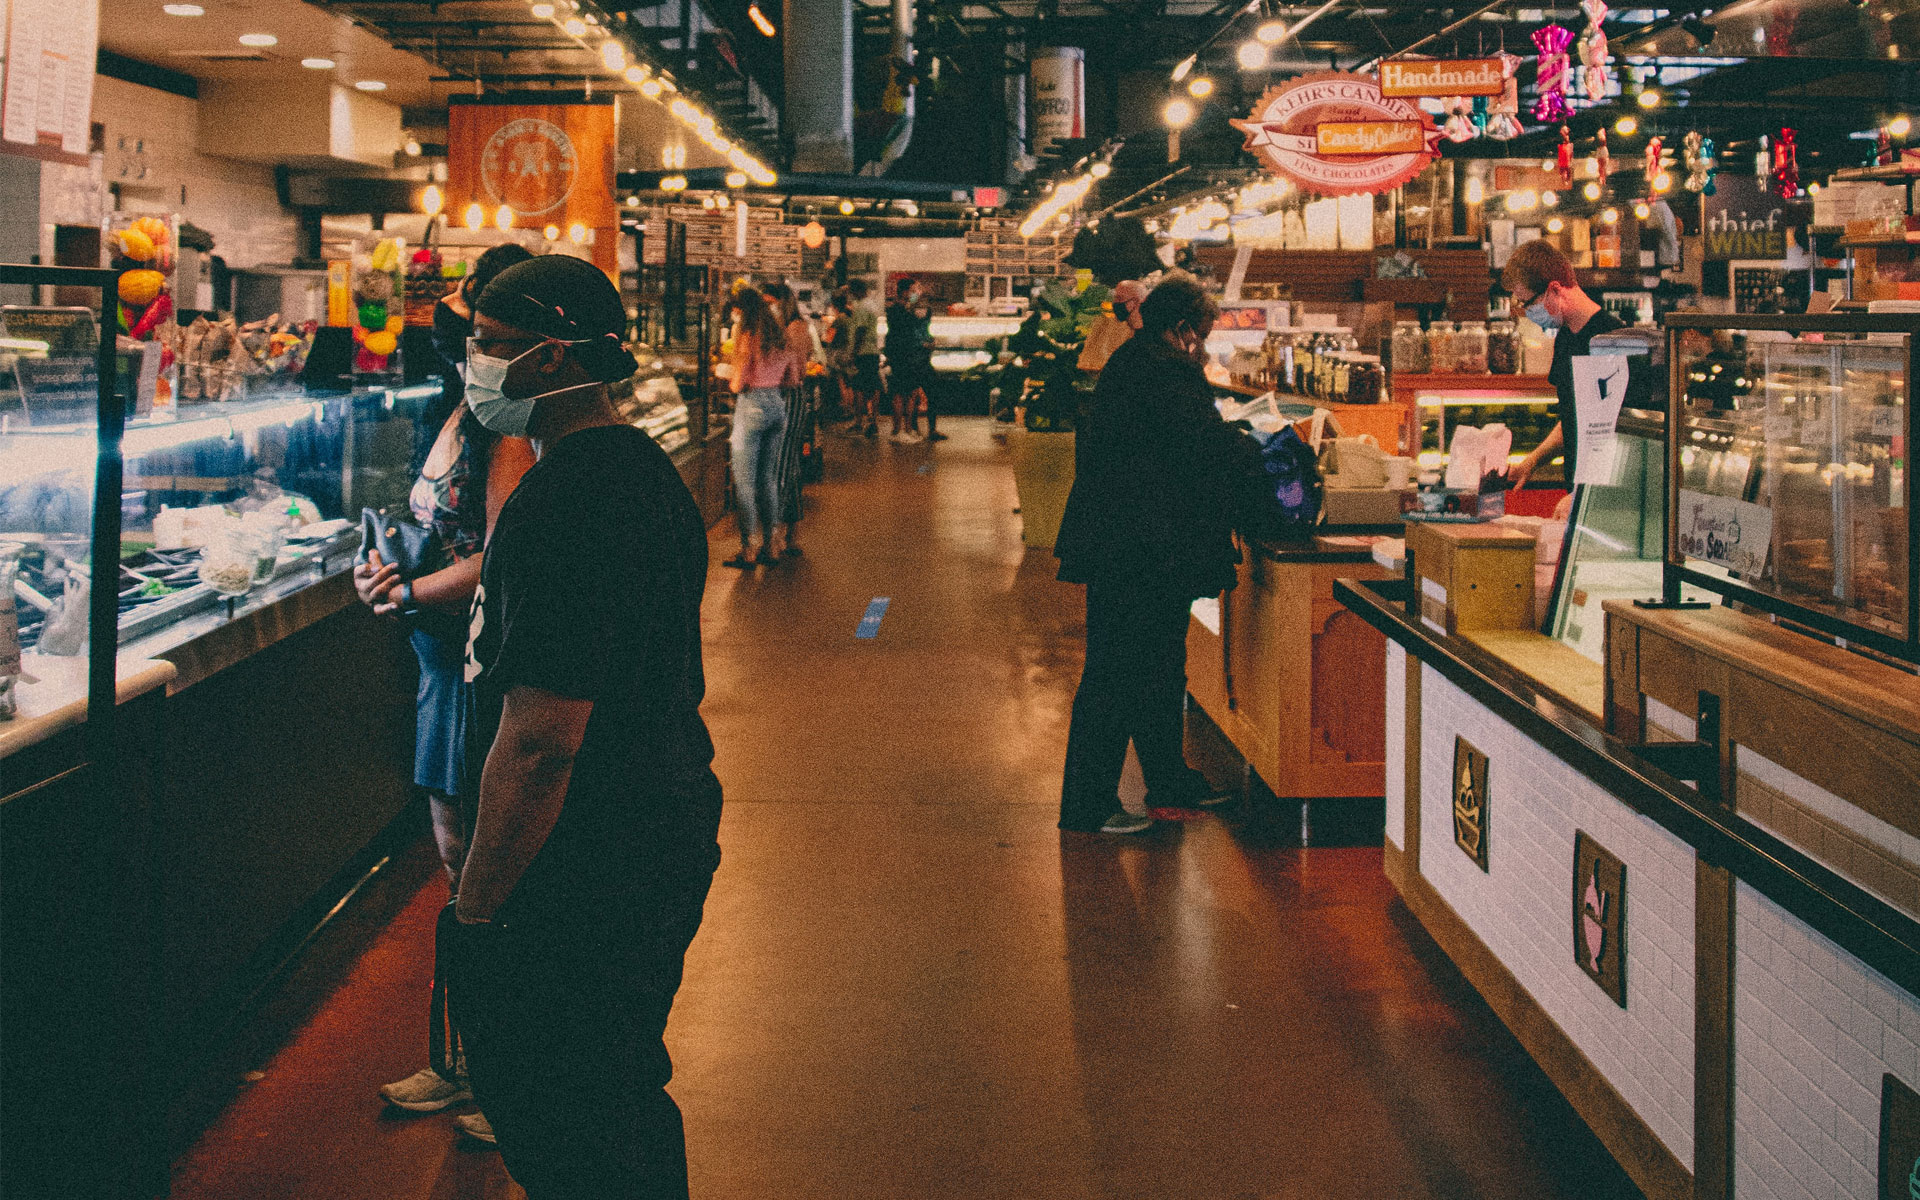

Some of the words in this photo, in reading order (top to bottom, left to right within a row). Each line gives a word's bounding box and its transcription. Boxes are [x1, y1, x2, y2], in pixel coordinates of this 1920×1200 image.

[1383, 62, 1500, 88] Handmade
[1276, 85, 1336, 117] KEHR'S
[1319, 127, 1374, 151] Candy
[1294, 158, 1319, 174] FINE
[1322, 163, 1394, 179] CHOCOLATES
[1708, 208, 1782, 232] thief
[1709, 232, 1781, 255] WINE
